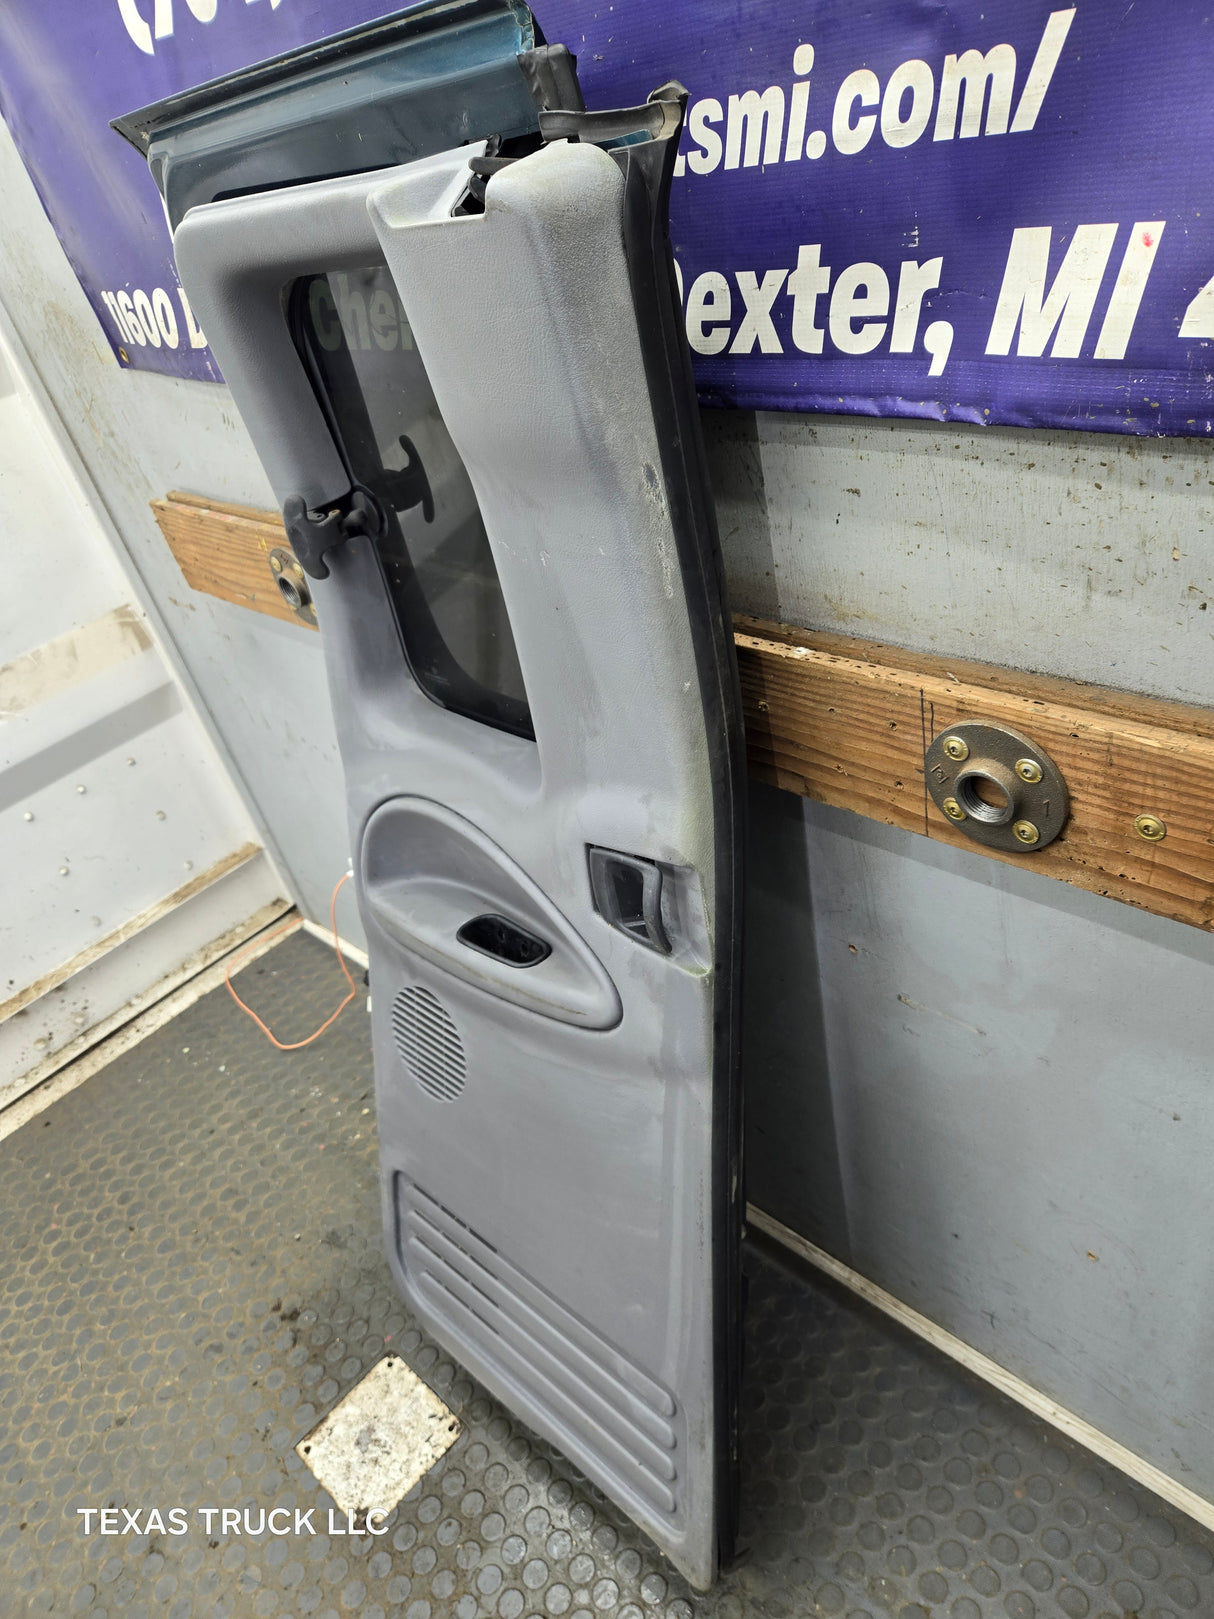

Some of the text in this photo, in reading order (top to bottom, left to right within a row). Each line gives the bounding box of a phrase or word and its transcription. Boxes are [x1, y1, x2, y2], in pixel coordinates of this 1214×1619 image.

[101, 287, 179, 349] 11600
[672, 243, 955, 376] exter,
[984, 221, 1166, 360] MI
